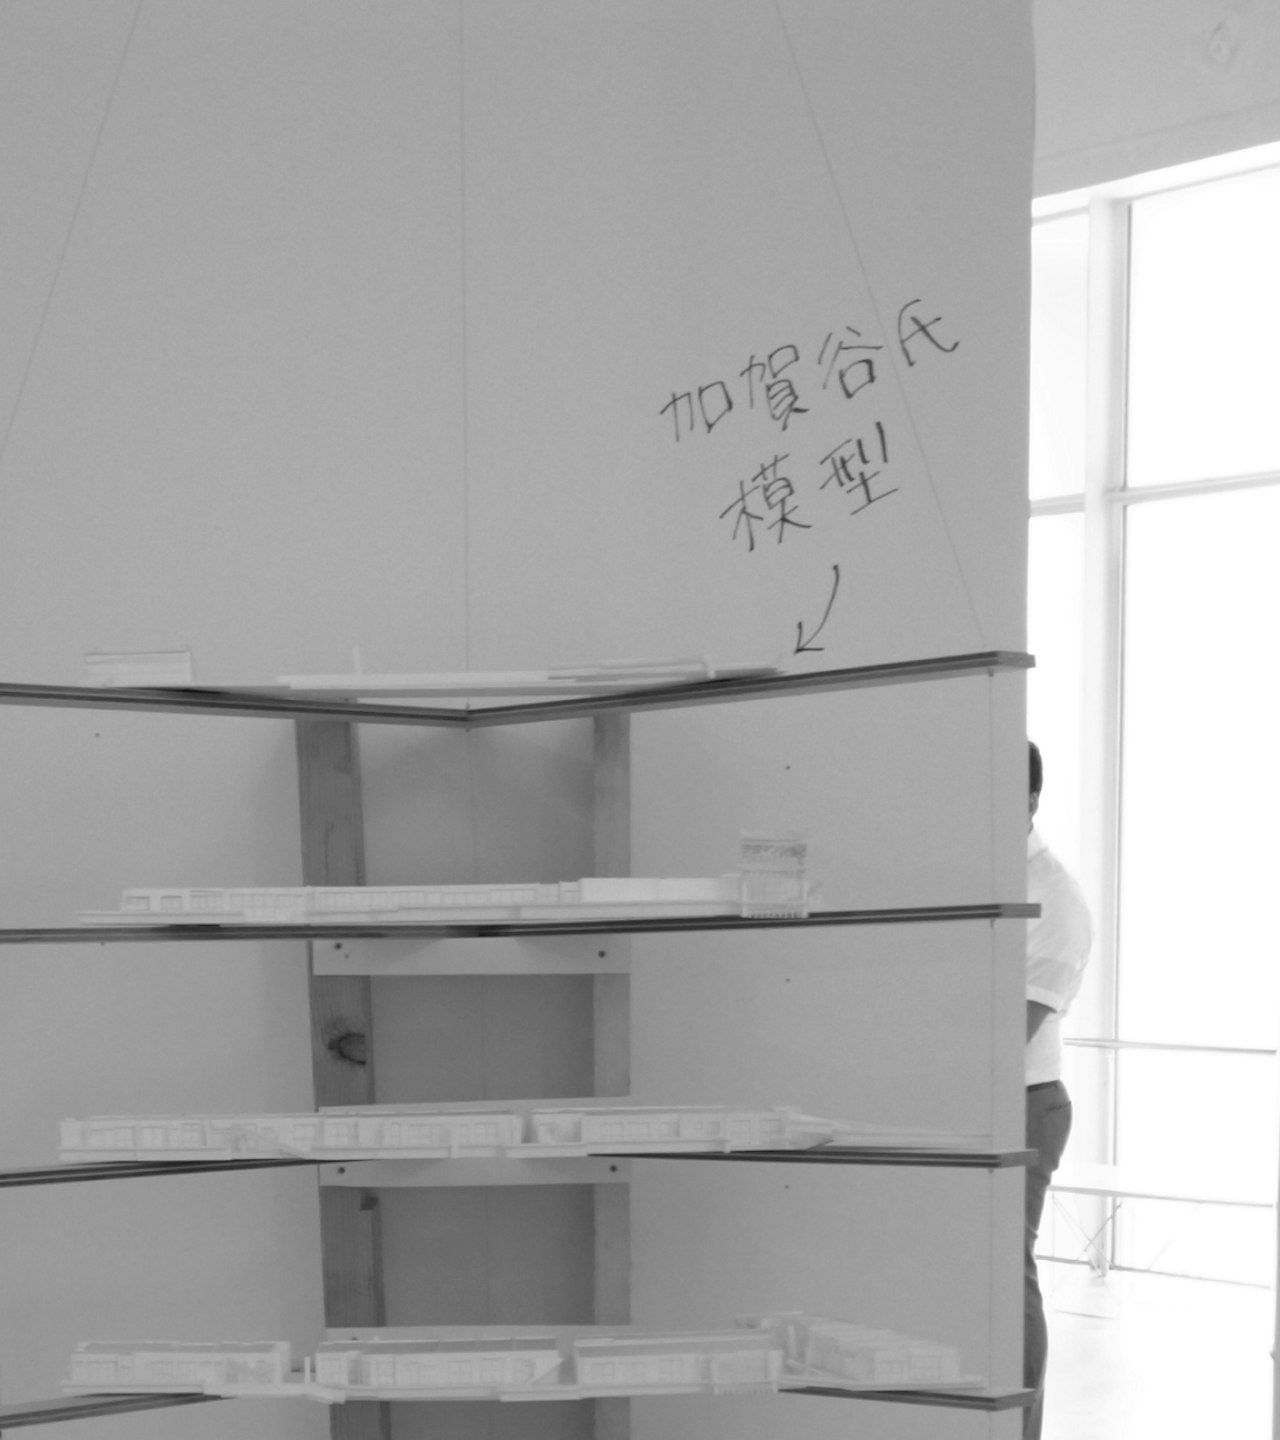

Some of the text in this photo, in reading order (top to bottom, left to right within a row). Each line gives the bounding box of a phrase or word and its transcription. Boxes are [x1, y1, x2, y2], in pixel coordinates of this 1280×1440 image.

[659, 298, 960, 443] 加賀谷氏
[719, 422, 898, 552] 模型
